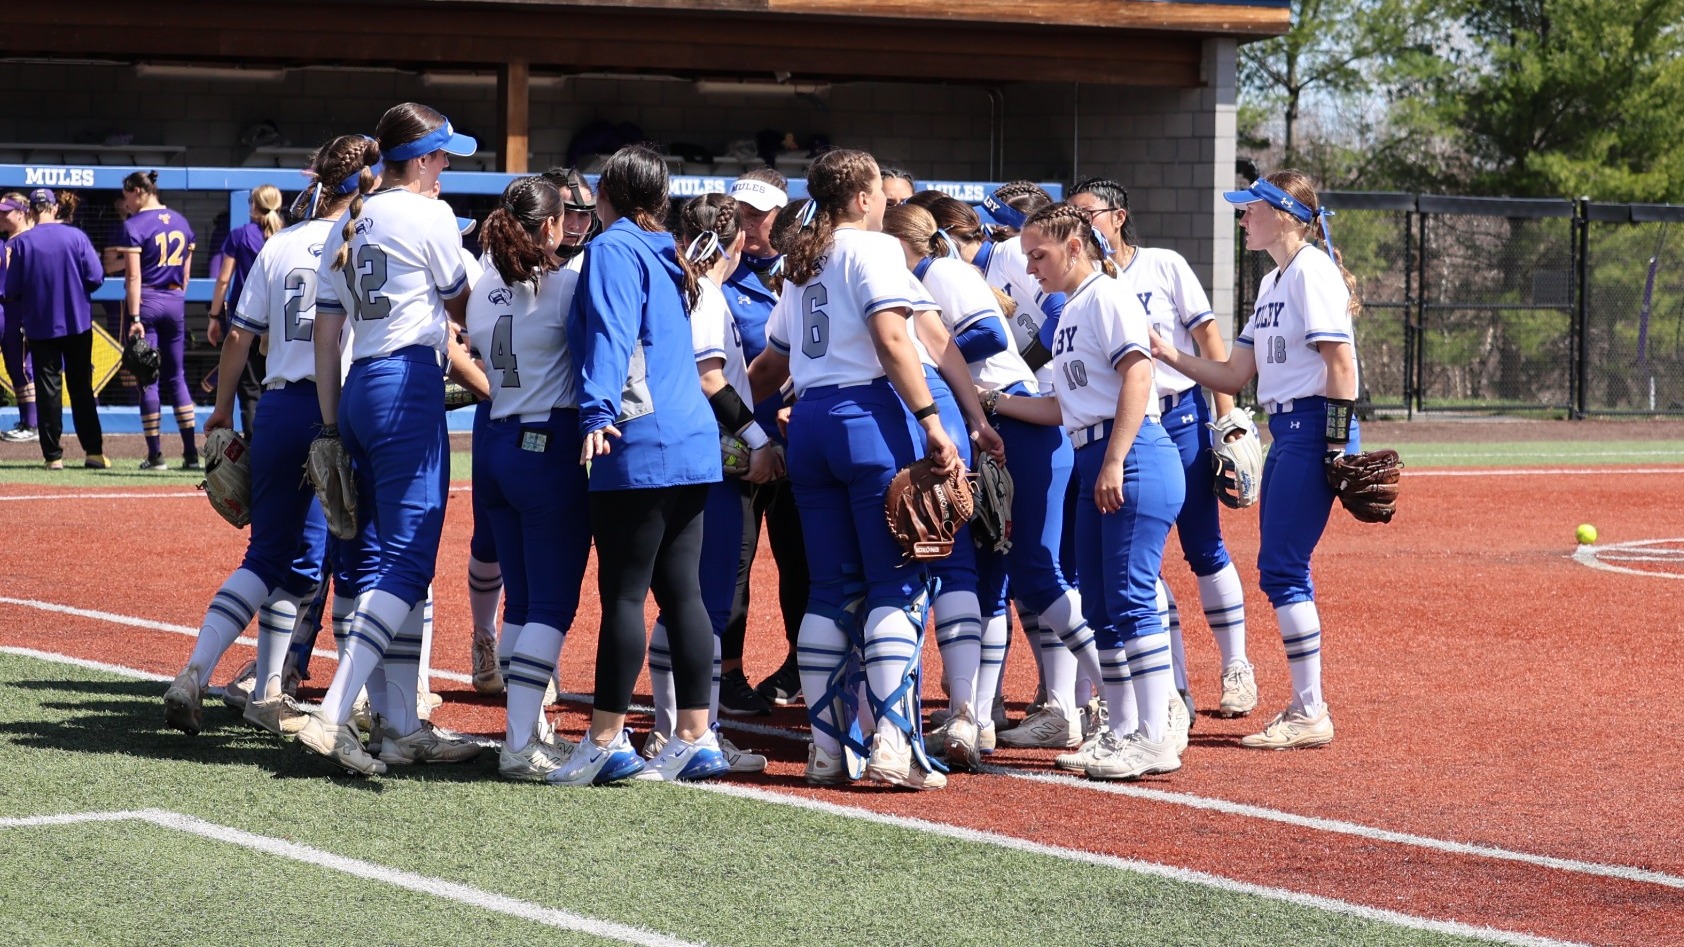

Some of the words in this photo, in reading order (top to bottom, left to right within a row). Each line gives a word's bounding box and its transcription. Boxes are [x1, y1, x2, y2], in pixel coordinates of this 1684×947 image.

[25, 168, 94, 186] MULES
[668, 179, 726, 195] MULES
[732, 182, 765, 194] MULES
[155, 230, 186, 267] 12
[343, 244, 391, 321] 12
[284, 267, 318, 342] 2
[801, 282, 829, 359] 6
[490, 315, 521, 388] 4
[1267, 335, 1287, 364] 18
[1062, 359, 1088, 391] 10
